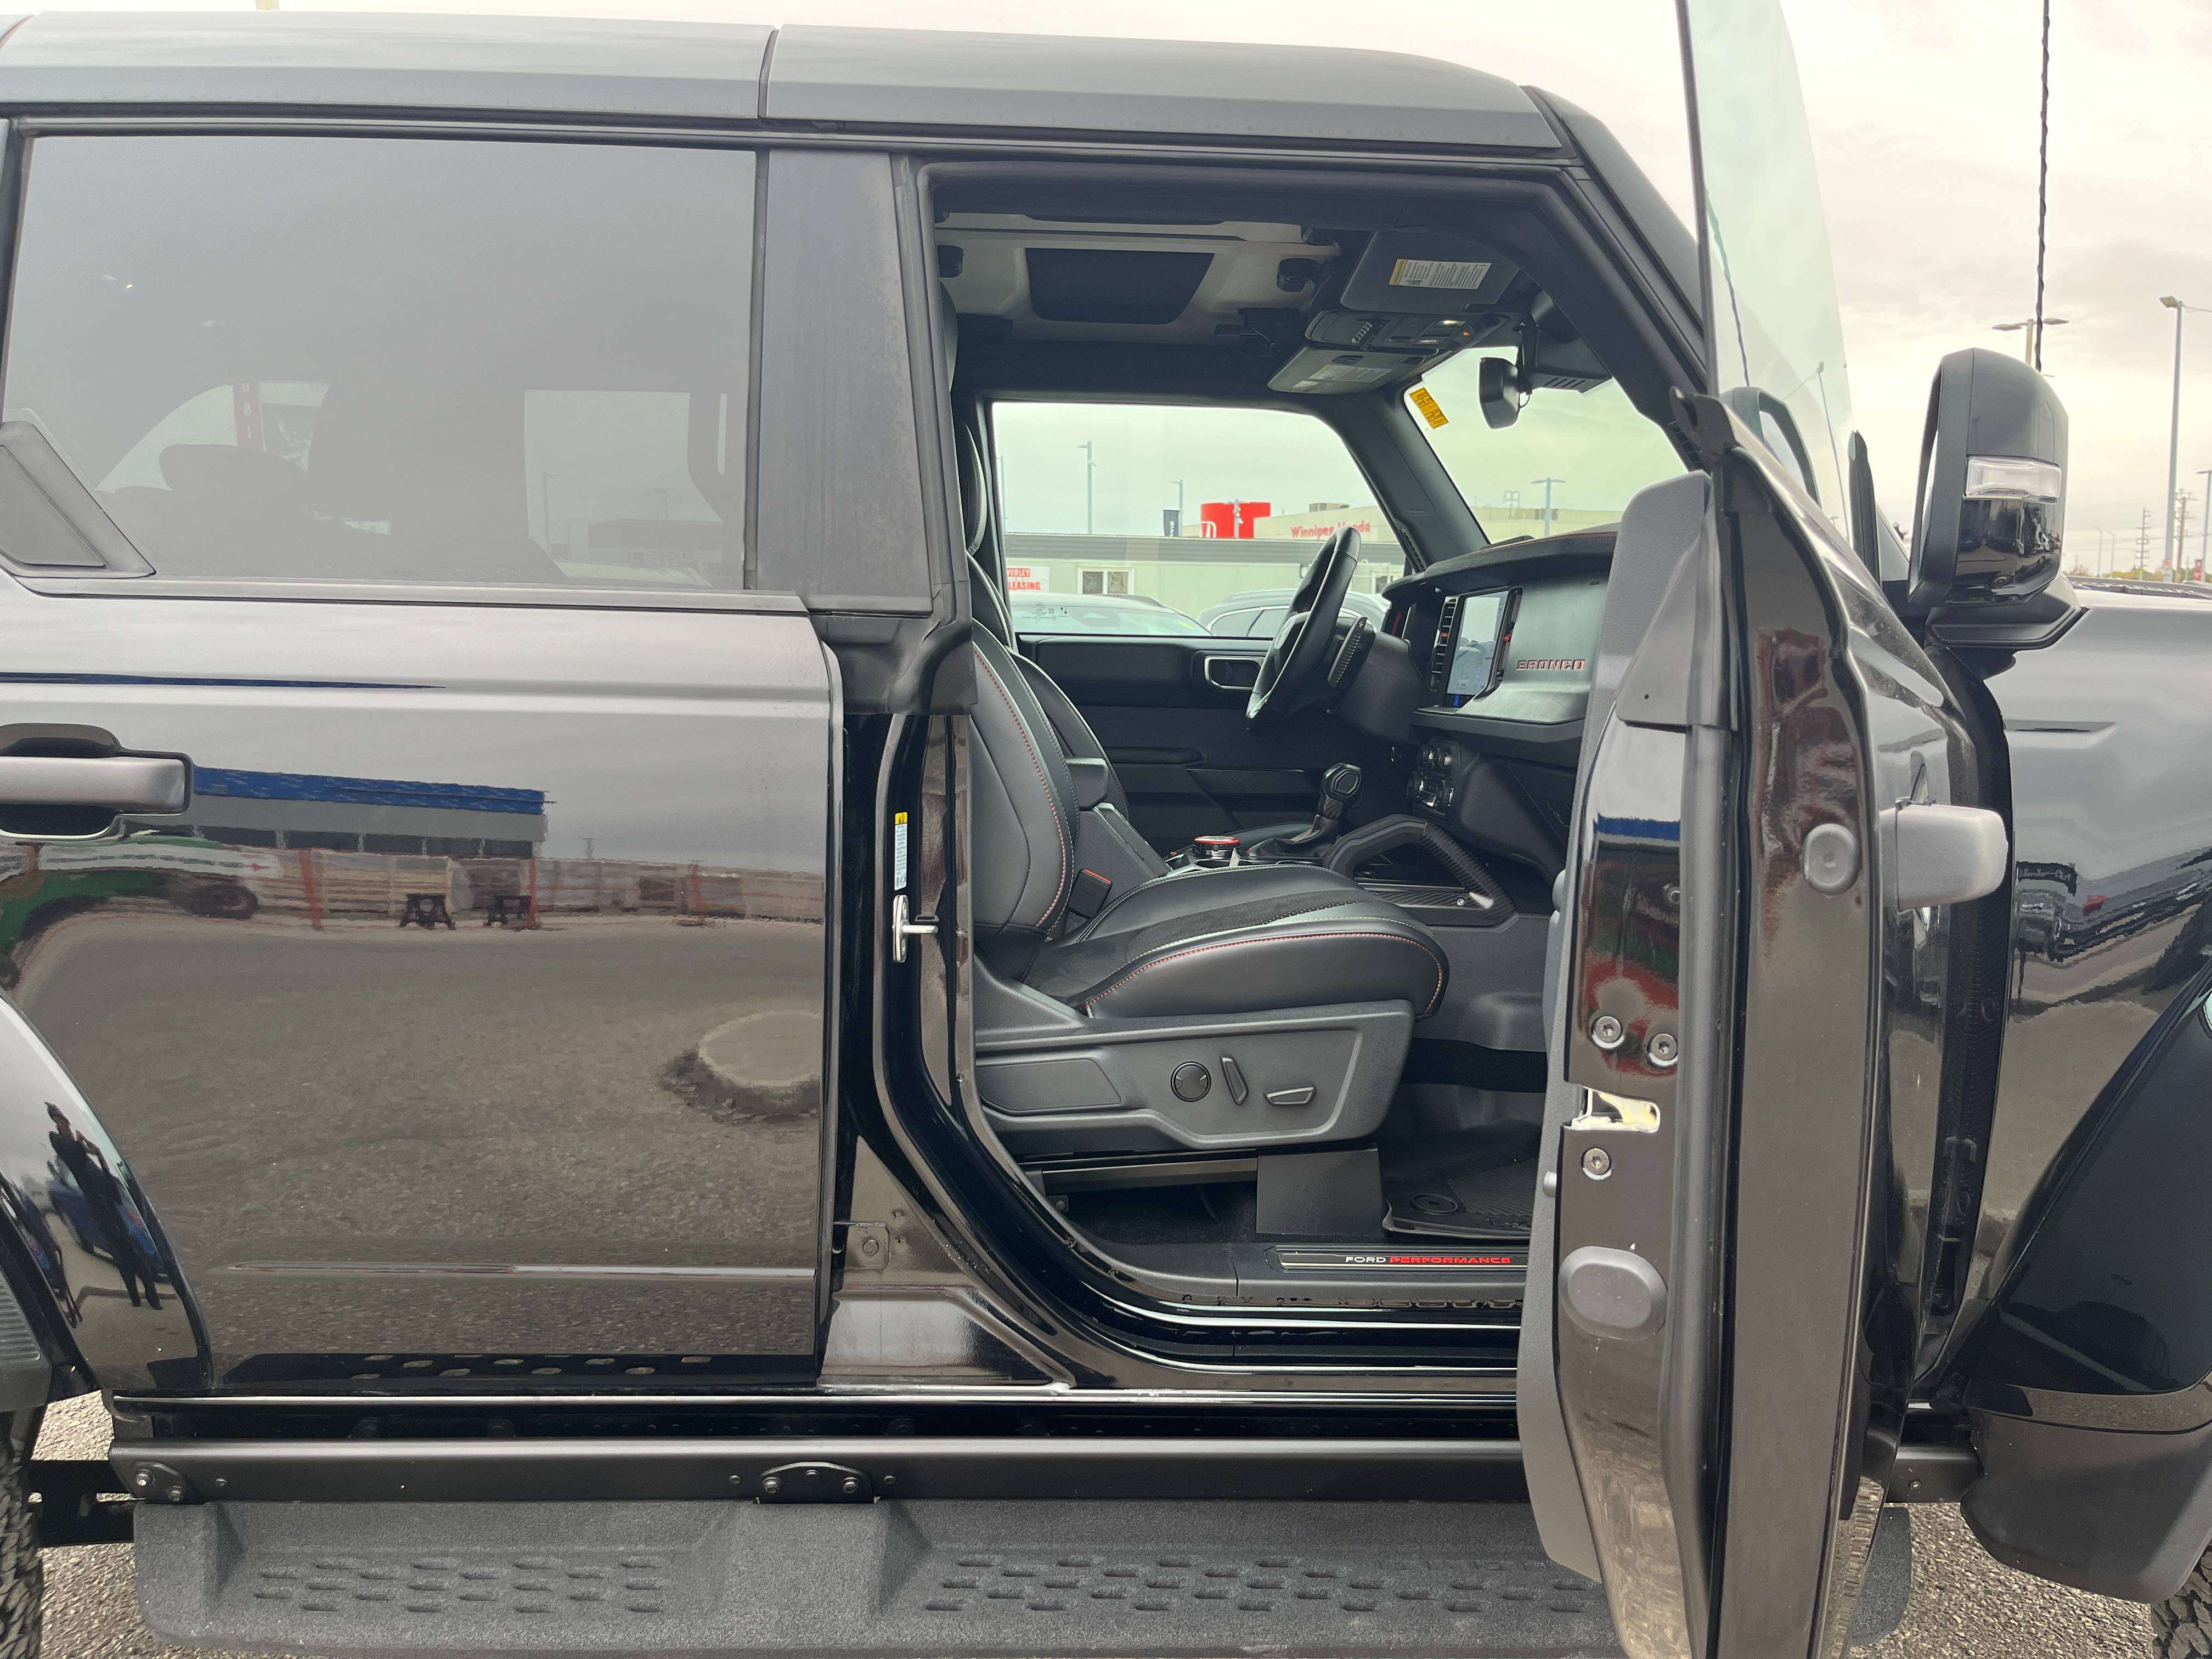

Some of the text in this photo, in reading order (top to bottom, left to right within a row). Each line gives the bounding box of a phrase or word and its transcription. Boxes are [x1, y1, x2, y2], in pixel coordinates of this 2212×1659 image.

[1290, 520, 1370, 539] Winnipeg nda
[1008, 581, 1041, 590] LEASING
[1516, 659, 1585, 670] BRONCO
